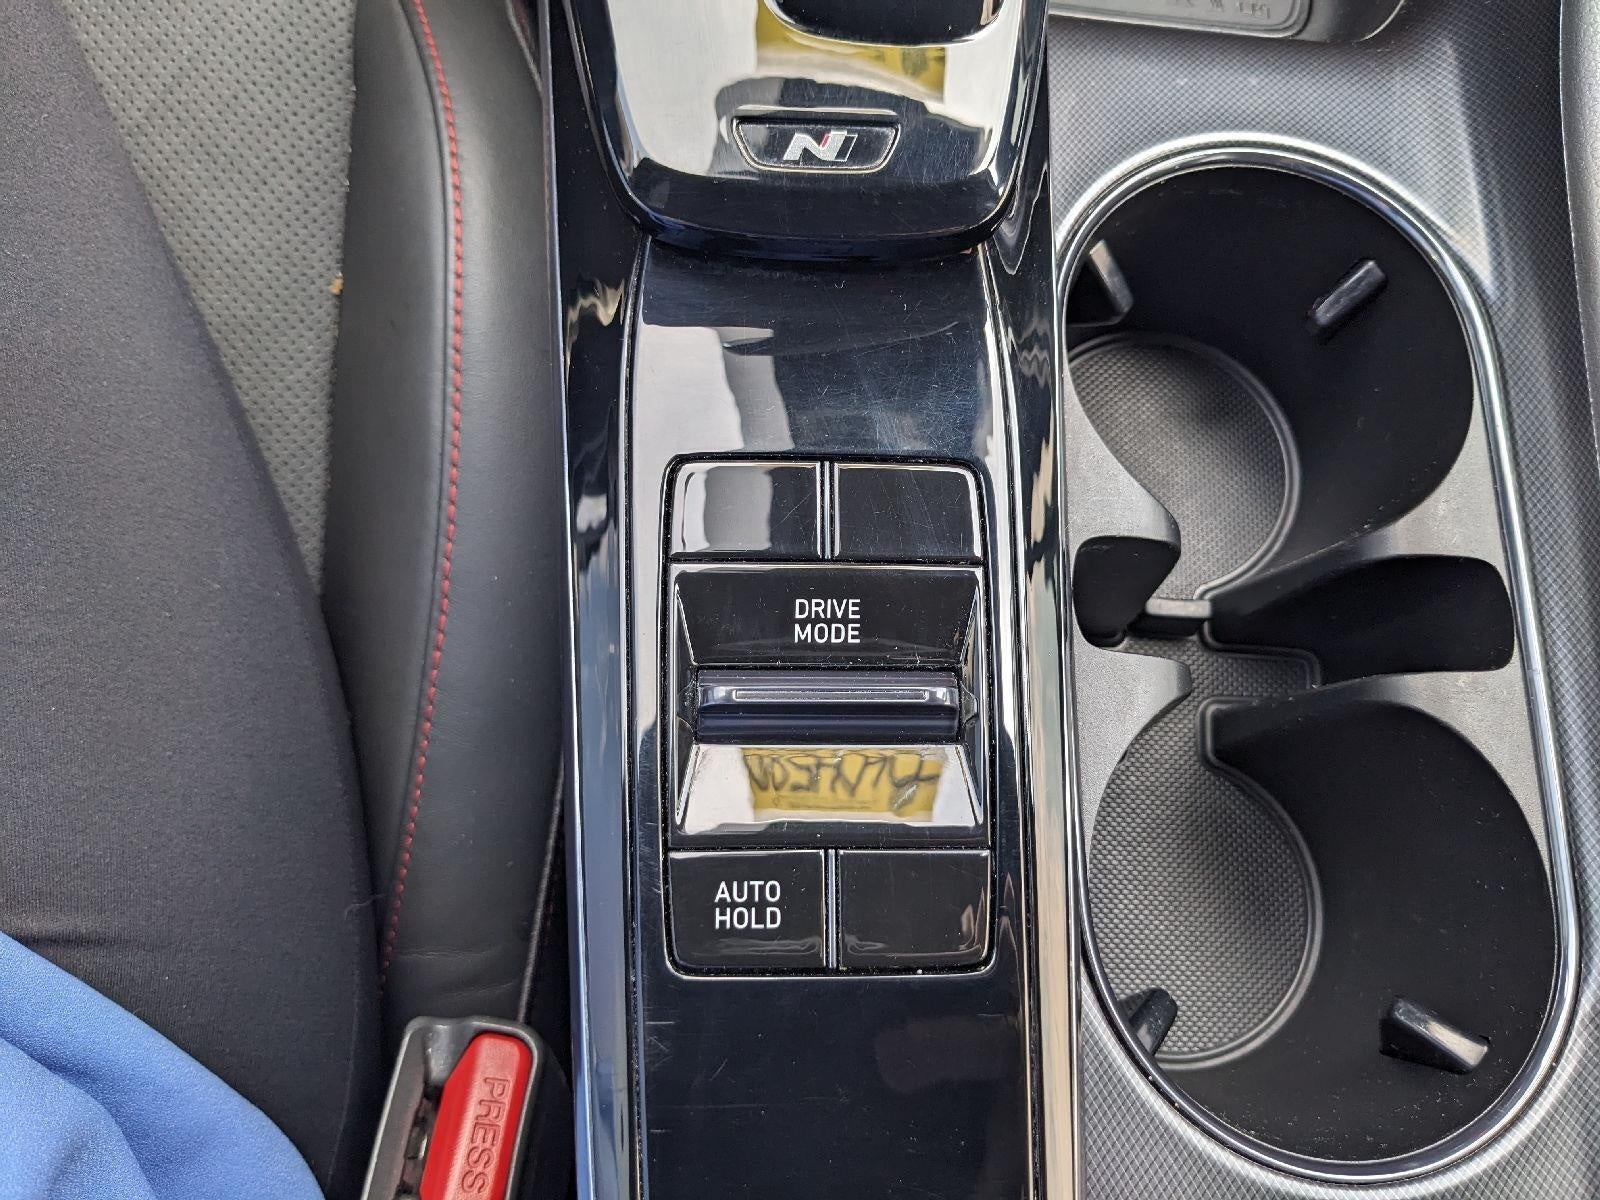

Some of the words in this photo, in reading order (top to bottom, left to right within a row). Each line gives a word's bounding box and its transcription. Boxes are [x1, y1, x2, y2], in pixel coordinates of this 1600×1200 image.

[794, 598, 861, 619] DRIVE
[794, 623, 861, 644] MODE
[714, 880, 781, 903] AUTO
[714, 907, 781, 930] HOLD
[460, 1076, 511, 1194] PRESS
